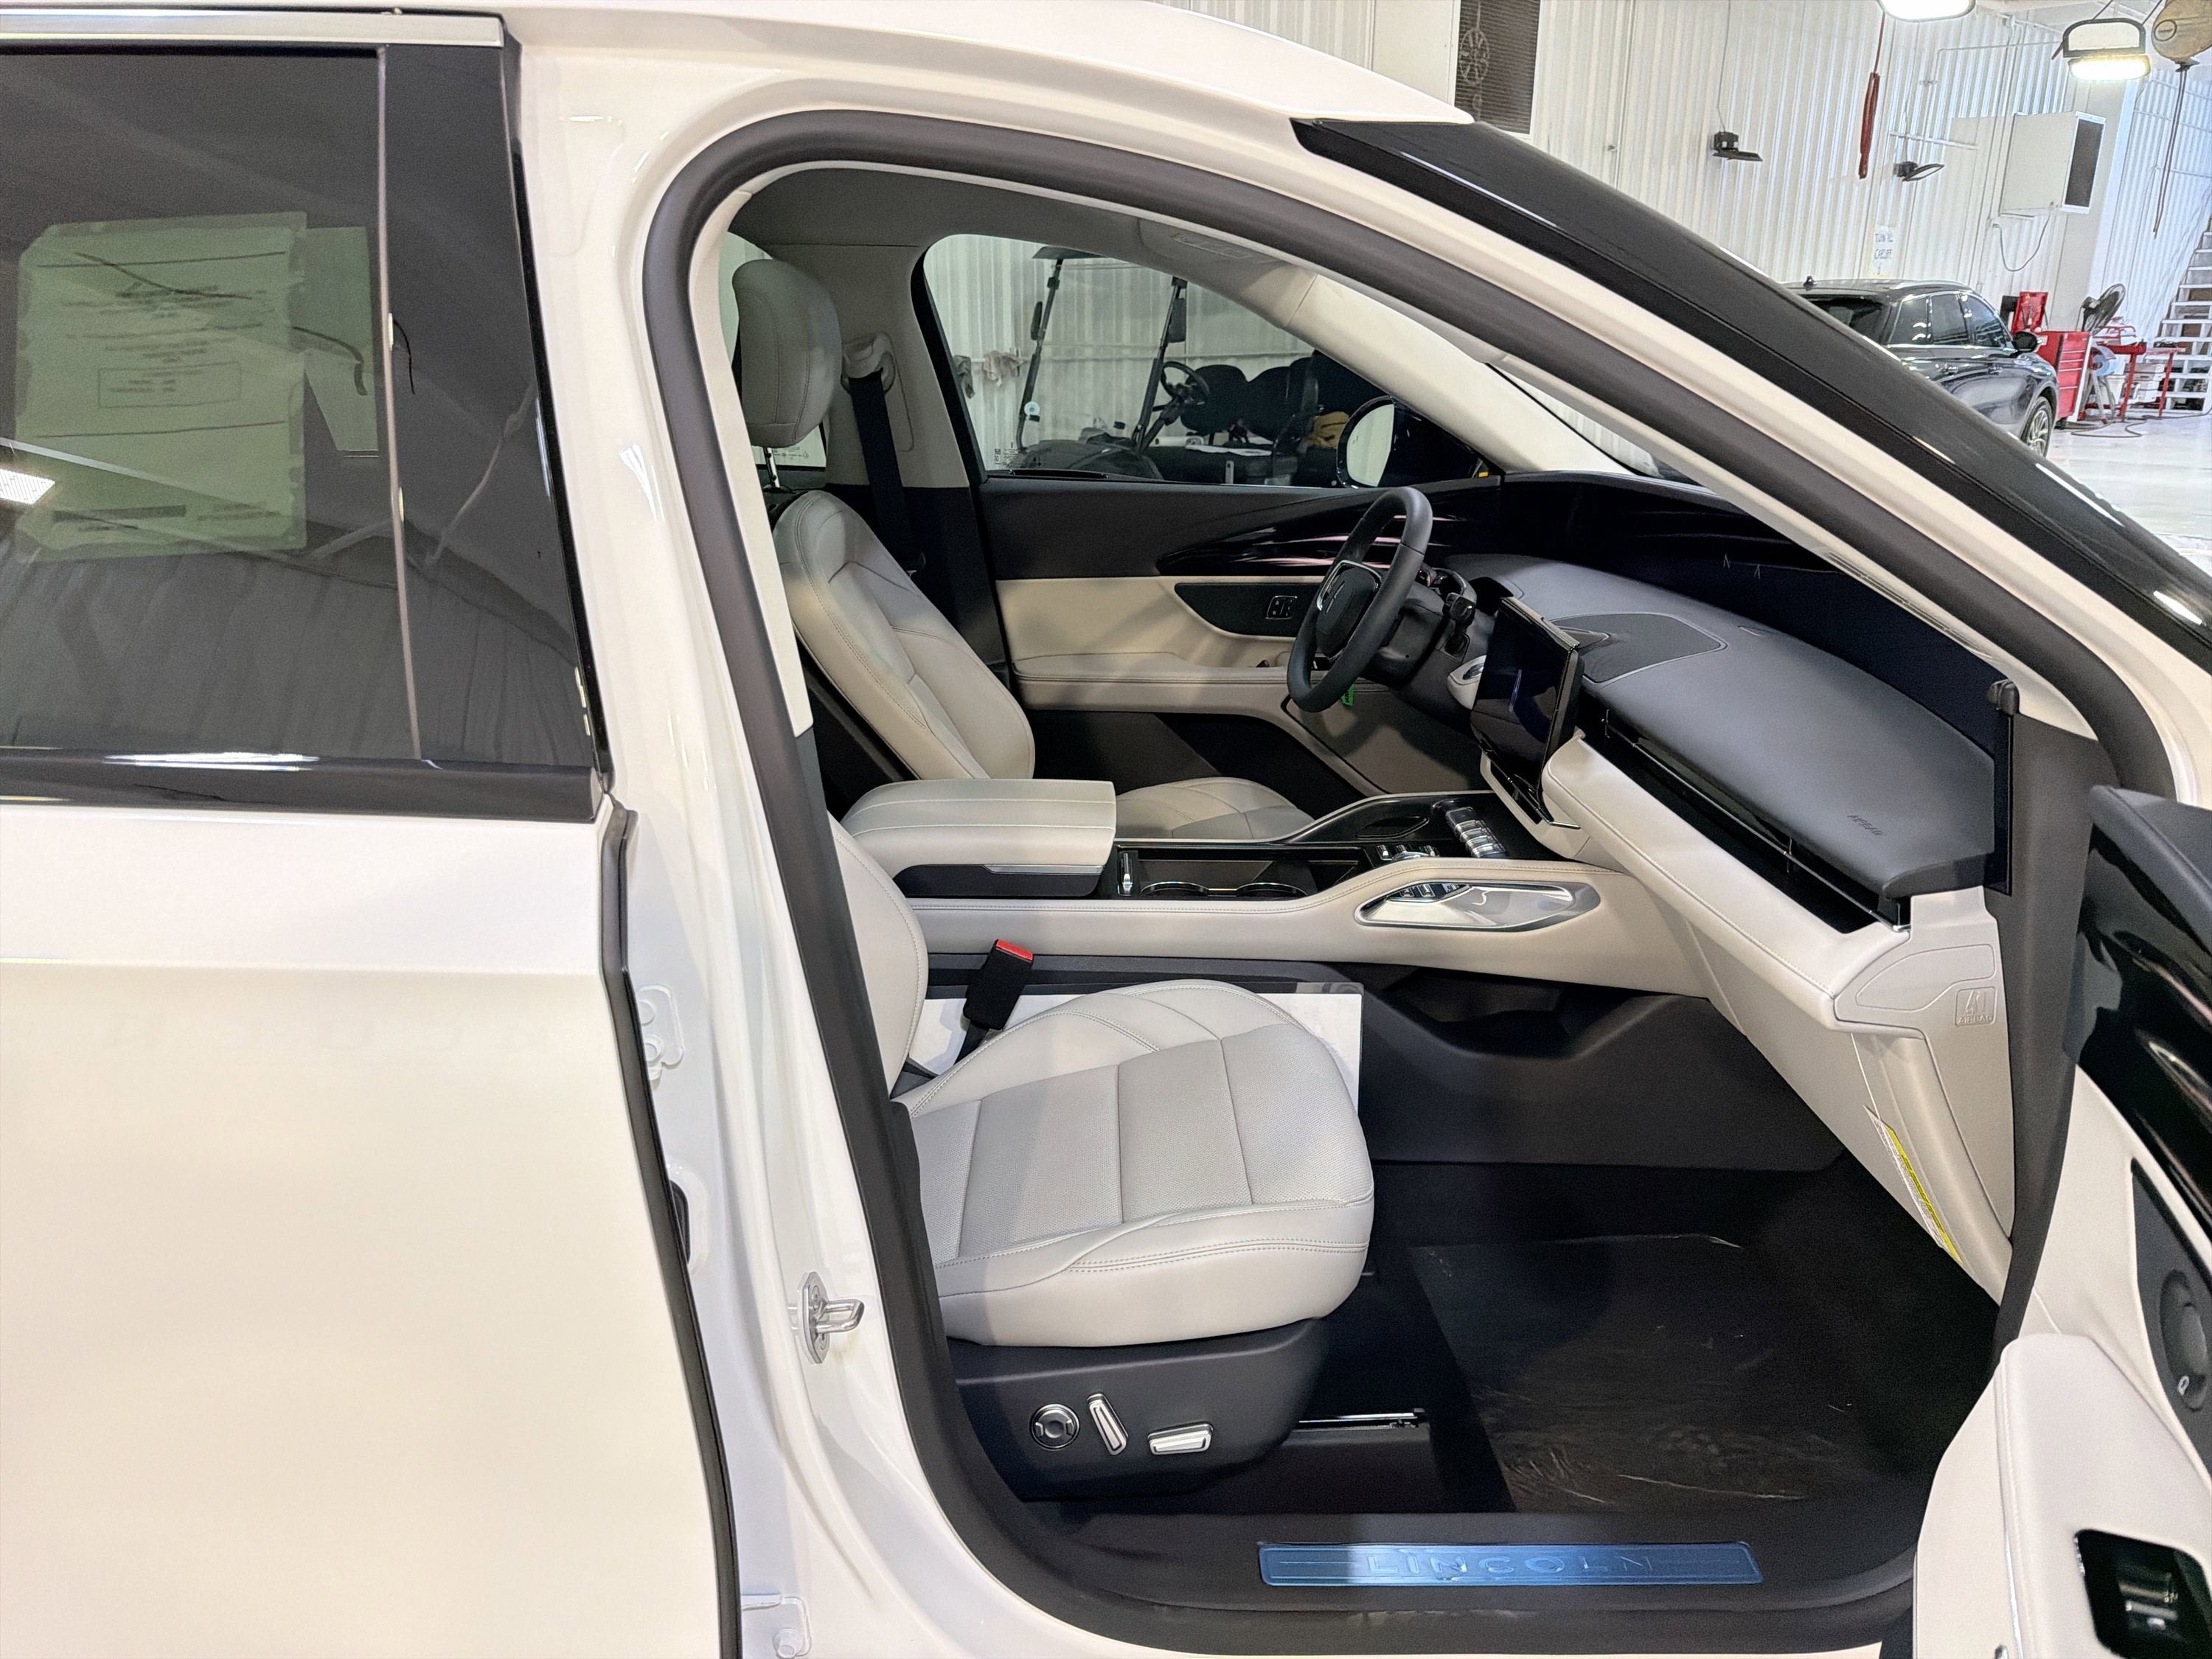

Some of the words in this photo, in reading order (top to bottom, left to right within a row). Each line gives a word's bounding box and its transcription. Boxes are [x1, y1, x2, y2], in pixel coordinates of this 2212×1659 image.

[1847, 815, 1885, 835] AIRBAG
[1958, 1015, 1994, 1024] AIRBAG
[1366, 1555, 1654, 1575] LINCOLN
